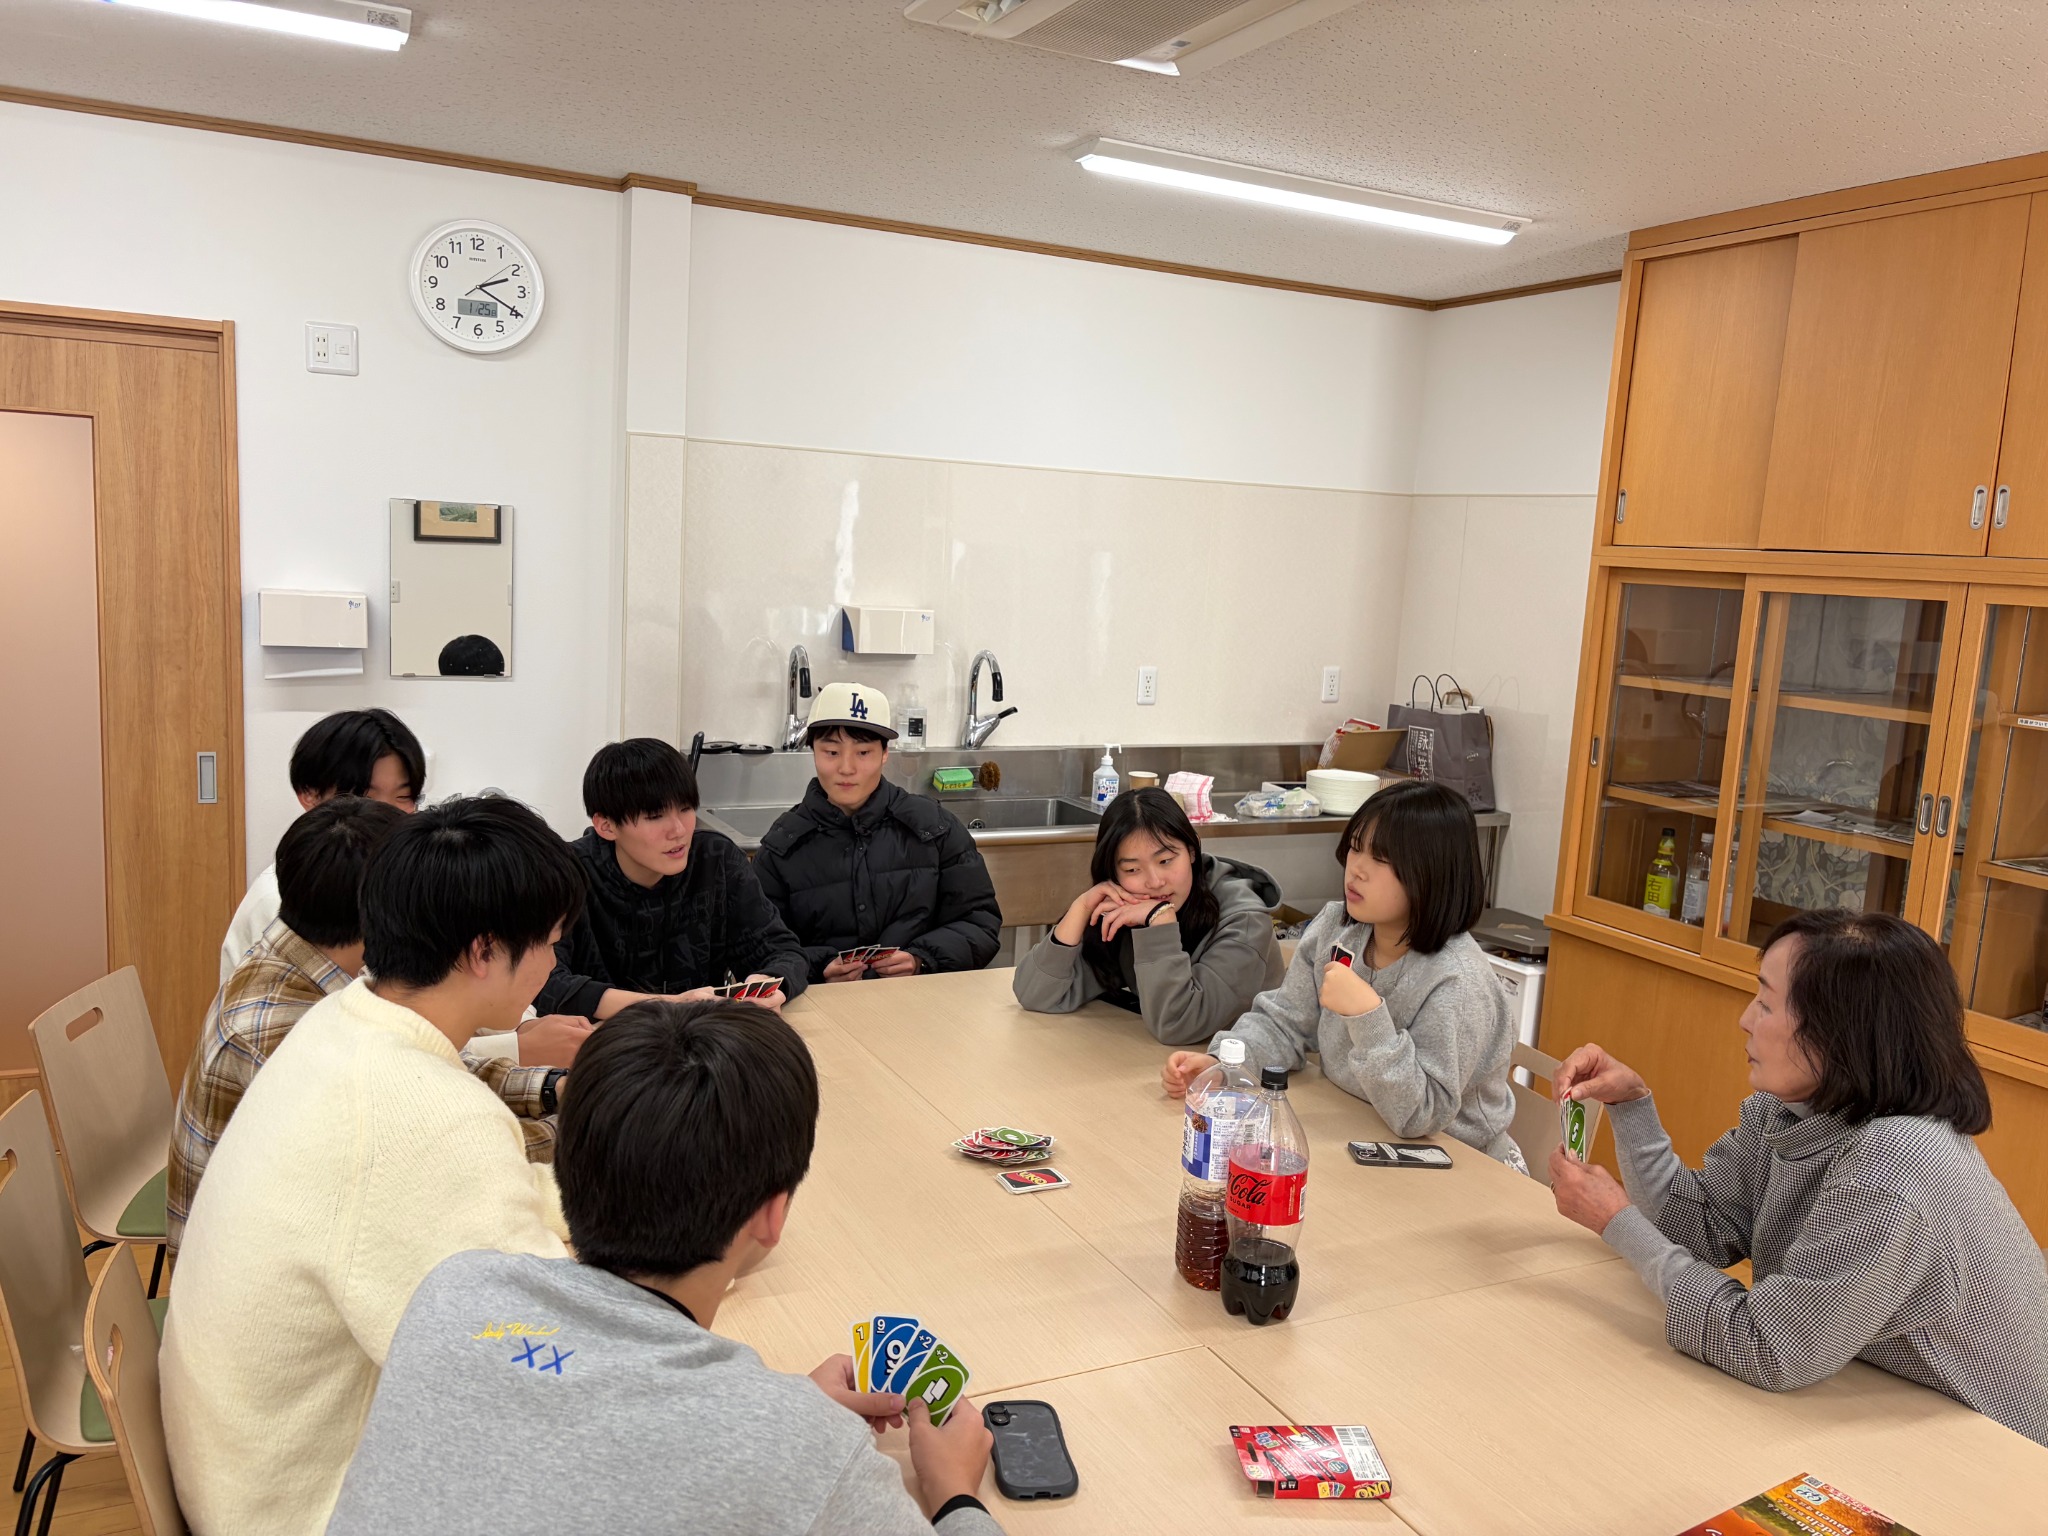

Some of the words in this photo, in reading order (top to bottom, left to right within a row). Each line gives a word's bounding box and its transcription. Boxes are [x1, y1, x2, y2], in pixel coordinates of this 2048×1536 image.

[449, 240, 462, 254] 11
[470, 237, 485, 251] 12
[497, 246, 503, 259] 1
[433, 255, 449, 269] 10
[511, 264, 521, 277] 2
[428, 275, 438, 288] 9
[517, 285, 526, 299] 3
[435, 297, 446, 310] 8
[510, 305, 520, 319] 4
[452, 316, 461, 329] 7
[495, 320, 505, 333] 5
[473, 323, 483, 337] 6
[850, 692, 868, 720] LA
[1229, 1197, 1251, 1210] SUGAR
[877, 1319, 886, 1333] 9
[856, 1326, 865, 1341] 1
[919, 1334, 933, 1349] +2
[936, 1349, 949, 1364] +2
[1354, 1481, 1391, 1498] UNO
[1815, 1510, 1854, 1535] Bauen
